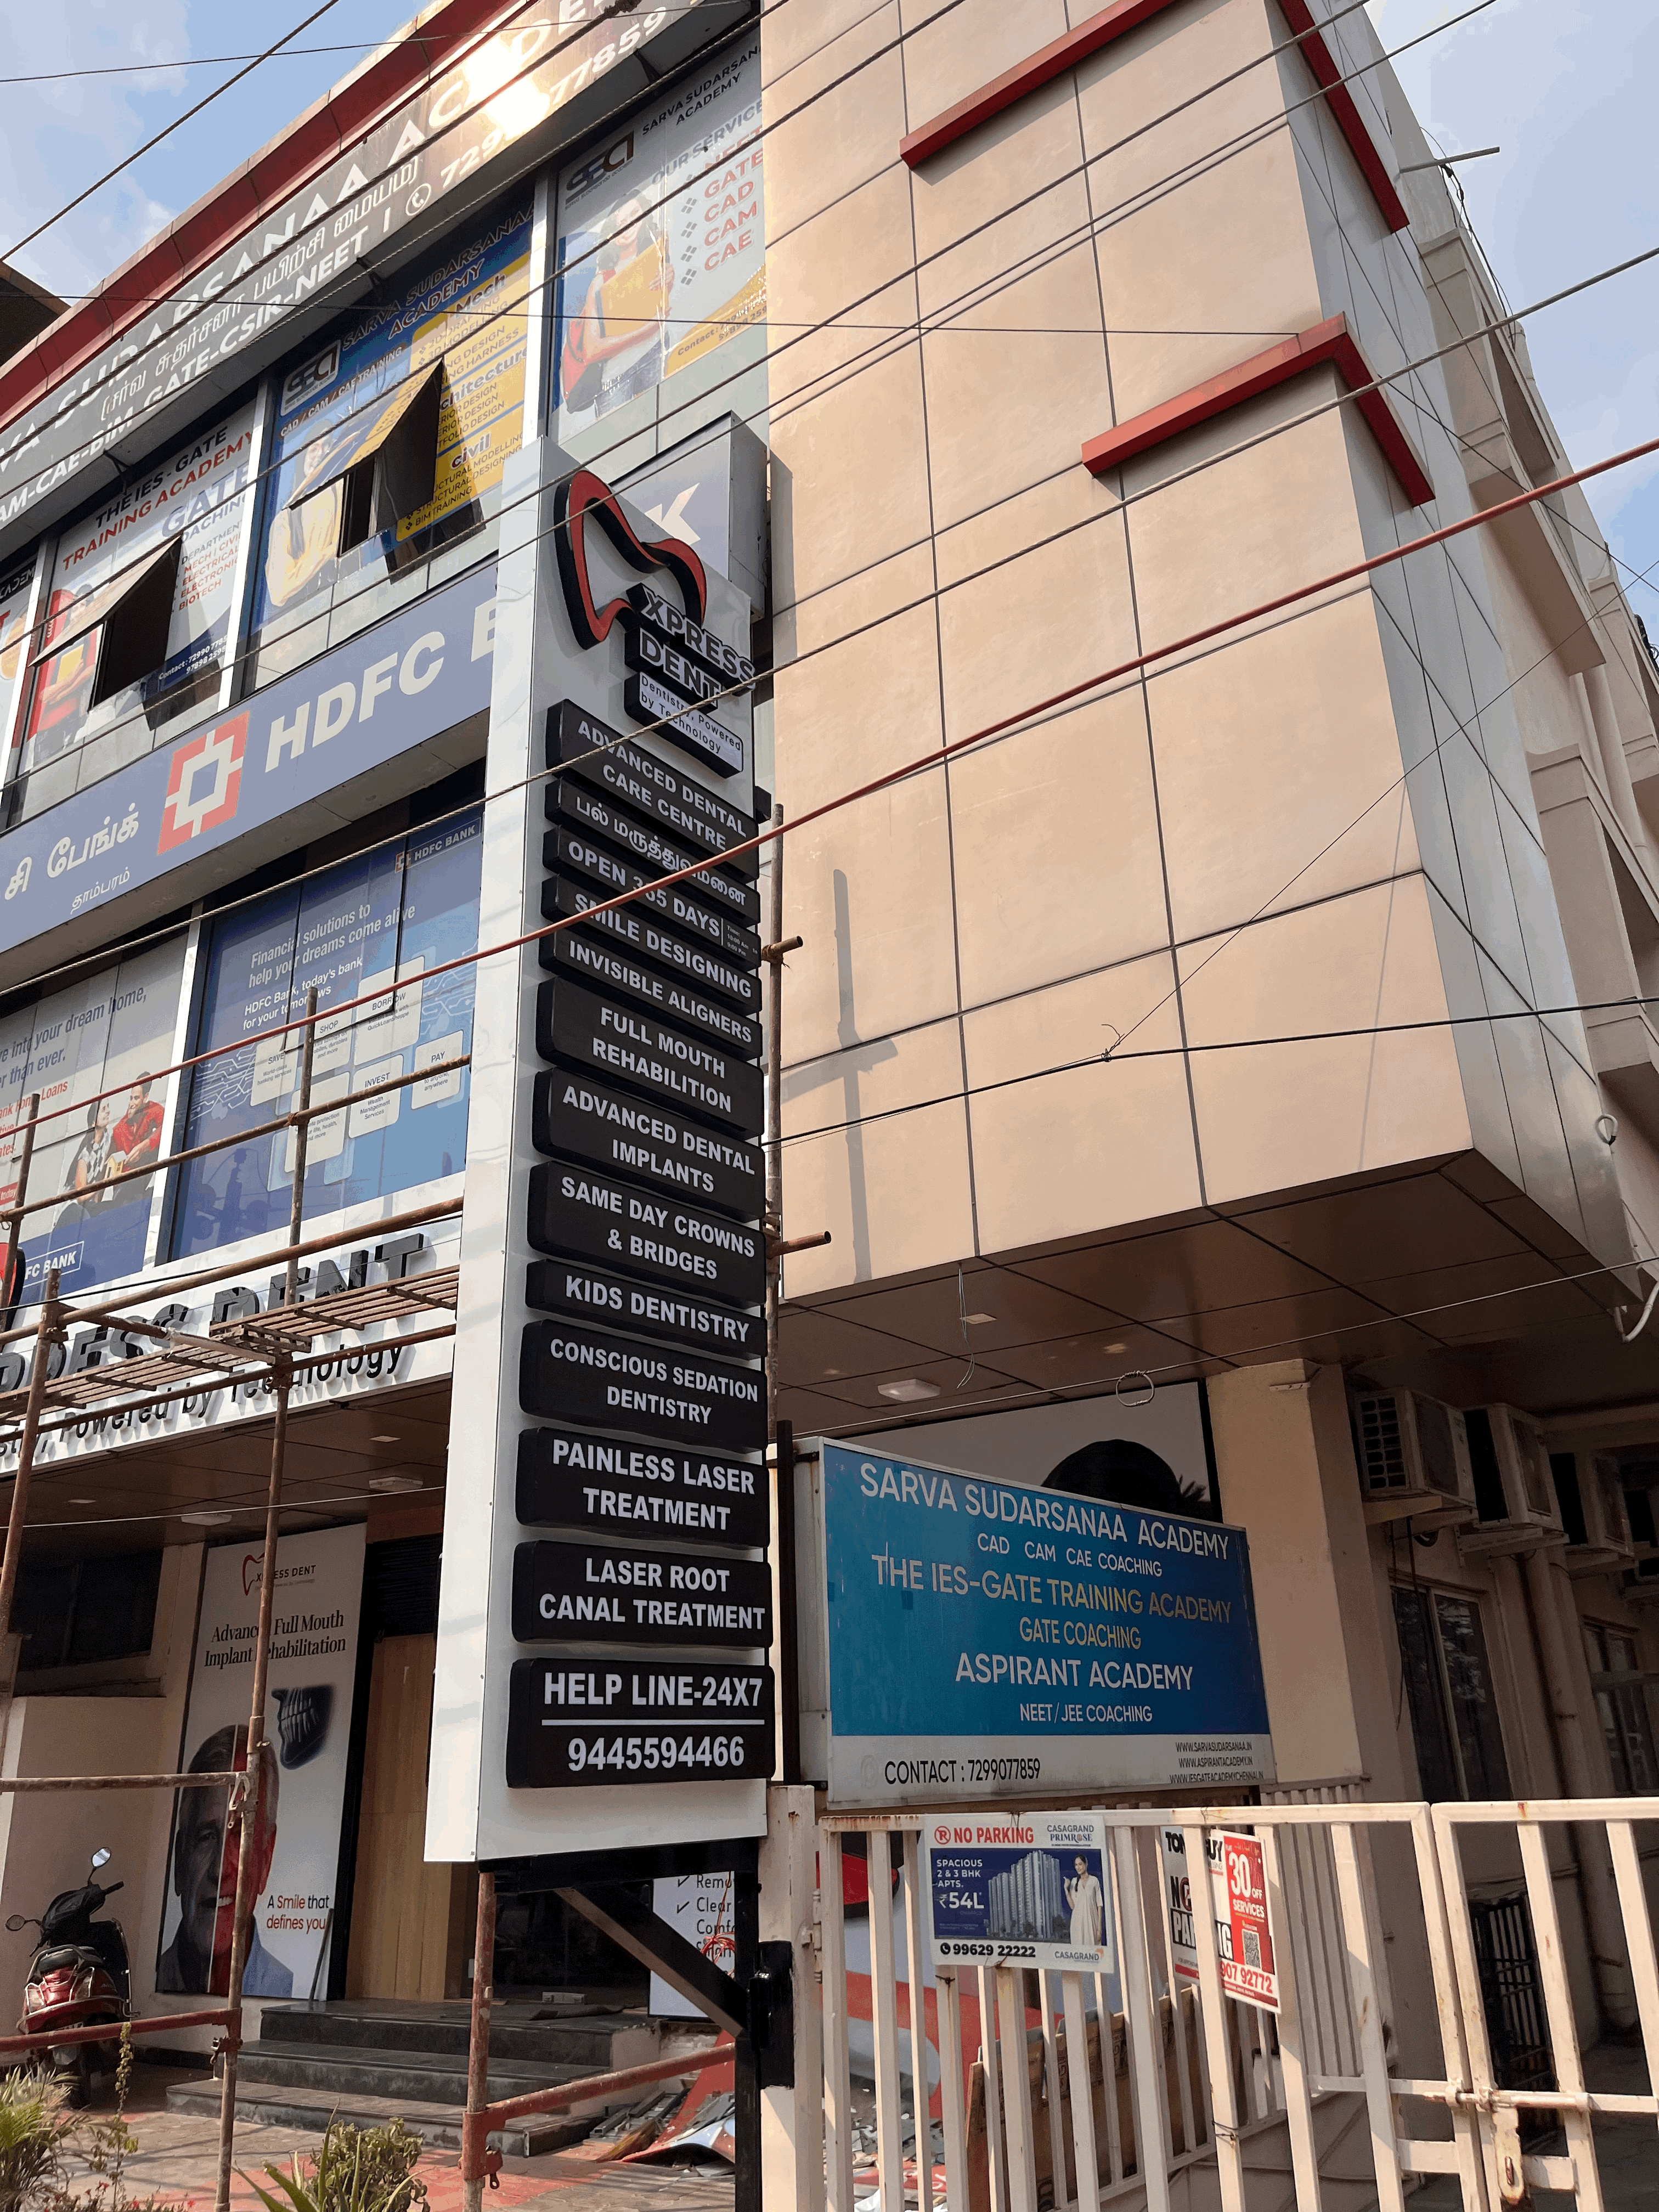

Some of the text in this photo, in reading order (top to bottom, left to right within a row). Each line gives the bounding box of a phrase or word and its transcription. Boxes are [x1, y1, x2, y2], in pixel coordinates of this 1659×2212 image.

[642, 101, 684, 136] SARVA
[676, 72, 741, 126] ACADEMY
[652, 152, 689, 184] OUR
[704, 148, 763, 199] GATE
[704, 181, 754, 222] CAD
[704, 201, 757, 246] CAM
[704, 229, 752, 271] CAE
[144, 225, 369, 411] GATE-CSIR-NEET
[387, 258, 485, 340] ACADEMY
[342, 300, 400, 351] SARVA
[466, 328, 519, 368] HARNESS
[280, 346, 403, 437] CAD CAM TRAINING
[463, 382, 497, 411] DESIGN
[464, 393, 499, 421] DESIGN
[470, 400, 505, 428] DESIGN
[452, 431, 491, 470] civil
[95, 426, 228, 529] THE IES GATE
[415, 486, 473, 527] BIM TRAINING
[63, 500, 153, 570] TRAINING
[184, 551, 212, 574] MECH
[179, 579, 222, 611] BIOTECH
[641, 585, 755, 690] XPRESS
[640, 628, 722, 707] DENT
[264, 631, 445, 773] HDFC
[641, 691, 654, 709] by
[698, 714, 741, 752] Powered
[578, 720, 747, 838] ADVANCED DENTAL
[576, 796, 609, 827] பல்
[603, 764, 726, 851] CARE CENTRE
[47, 803, 139, 878] பேங்க்
[414, 825, 476, 861] HDFC BANK
[70, 866, 131, 915] தாம்பரம்
[568, 841, 720, 938] OPEN DAYS
[249, 964, 273, 989] help
[302, 936, 346, 964] dreams
[348, 919, 381, 944] come
[251, 904, 371, 968] Financial solutions to
[574, 893, 752, 998] SMILE DESIGNING
[245, 957, 363, 1016] HDFC today's bank
[569, 940, 752, 1043] INVISIBLE ALIGNERS
[35, 1022, 64, 1051] your
[65, 1005, 105, 1034] dream
[108, 987, 147, 1015] home,
[243, 1009, 278, 1031] for your
[319, 1020, 338, 1034] SHOP
[268, 1052, 285, 1064] SAVE
[431, 1051, 445, 1063] PAY
[600, 1006, 725, 1079] FULL MOUTH
[9, 1048, 66, 1085] than ever.
[364, 1072, 390, 1088] INVEST
[592, 1037, 731, 1113] REHABILITION
[41, 1081, 69, 1101] Loans
[562, 1085, 755, 1175] ADVANCED DENTAL
[612, 1138, 714, 1193] IMPLANTS
[561, 1176, 755, 1258] SAME DAY CROWNS
[43, 1250, 77, 1275] BANK
[607, 1228, 718, 1280] & BRIDGES
[565, 1274, 750, 1343] KIDS DENTISTRY
[550, 1338, 759, 1402] CONSCIOUS SEDATION
[606, 1385, 712, 1425] DENTISTRY
[552, 1438, 755, 1495] PAINLESS LASER
[582, 1487, 731, 1531] TREATMENT
[860, 1462, 1229, 1561] SARVA SUDARSANAA ACADEMY
[291, 1565, 317, 1577] DENT
[585, 1557, 730, 1592] LASER ROOT
[977, 1533, 1163, 1578] CAD CAM CAE COACHING
[871, 1553, 1232, 1624] THE IES-GATE TRAINING ACADEMY
[274, 1609, 345, 1635] Full Mouth
[539, 1593, 766, 1630] CANAL TREATMENT
[1019, 1616, 1142, 1650] GATE COACHING
[204, 1646, 253, 1670] Implant
[954, 1651, 1193, 1691] ASPIRANT ACADEMY
[544, 1672, 763, 1707] HELP LINE-24X7
[1086, 1705, 1153, 1723] COACHING
[567, 1735, 744, 1771] 9445594466
[884, 1758, 1041, 1785] CONTACT 7299077859
[953, 1826, 1034, 1843] NO PARKING
[1047, 1825, 1094, 1833] CASAGRAND
[936, 1859, 983, 1867] SPACIOUS
[937, 1869, 981, 1878] 2 & 3 BHK
[267, 1894, 330, 1909] A Smile that
[937, 1879, 964, 1888] APTS.
[1251, 1887, 1263, 1901] OFF
[696, 1896, 732, 1913] Clear
[1232, 1898, 1265, 1919] SERVICES
[266, 1914, 326, 1935] defines you
[952, 1943, 1036, 1958] 99629 22222
[1054, 1950, 1099, 1961] CASAGRAND
[1240, 1964, 1273, 1995] 92772
